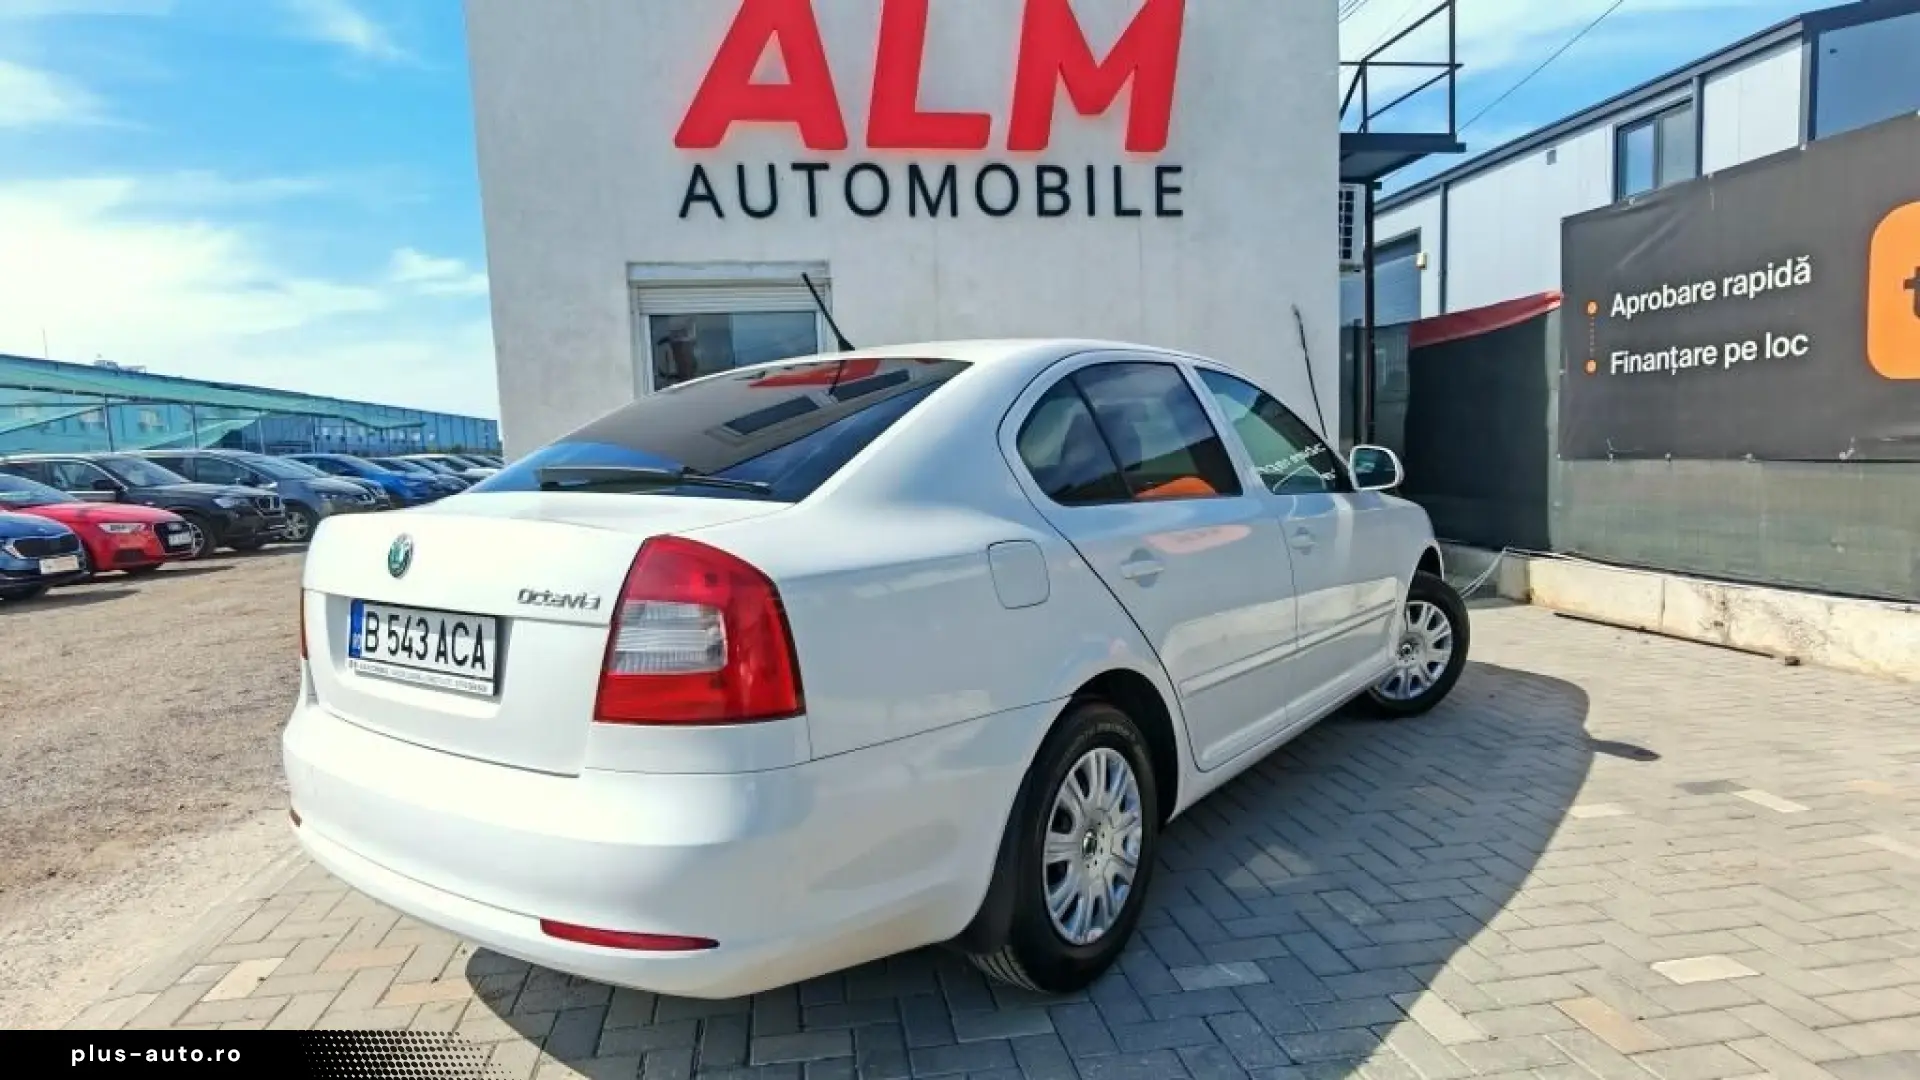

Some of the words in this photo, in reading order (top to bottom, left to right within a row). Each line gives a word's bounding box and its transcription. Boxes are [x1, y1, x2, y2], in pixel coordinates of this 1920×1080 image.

[674, 0, 1186, 151] ALM
[679, 163, 1184, 218] AUTOMOBILE
[1610, 280, 1716, 319] Aprobare
[1722, 254, 1811, 299] rapidă
[1610, 344, 1719, 376] Finanțare
[1724, 339, 1758, 369] pe
[1765, 331, 1809, 359] loc
[517, 588, 601, 610] Octavia
[365, 610, 380, 653] B
[387, 614, 430, 661] 543
[434, 619, 487, 671] ACA
